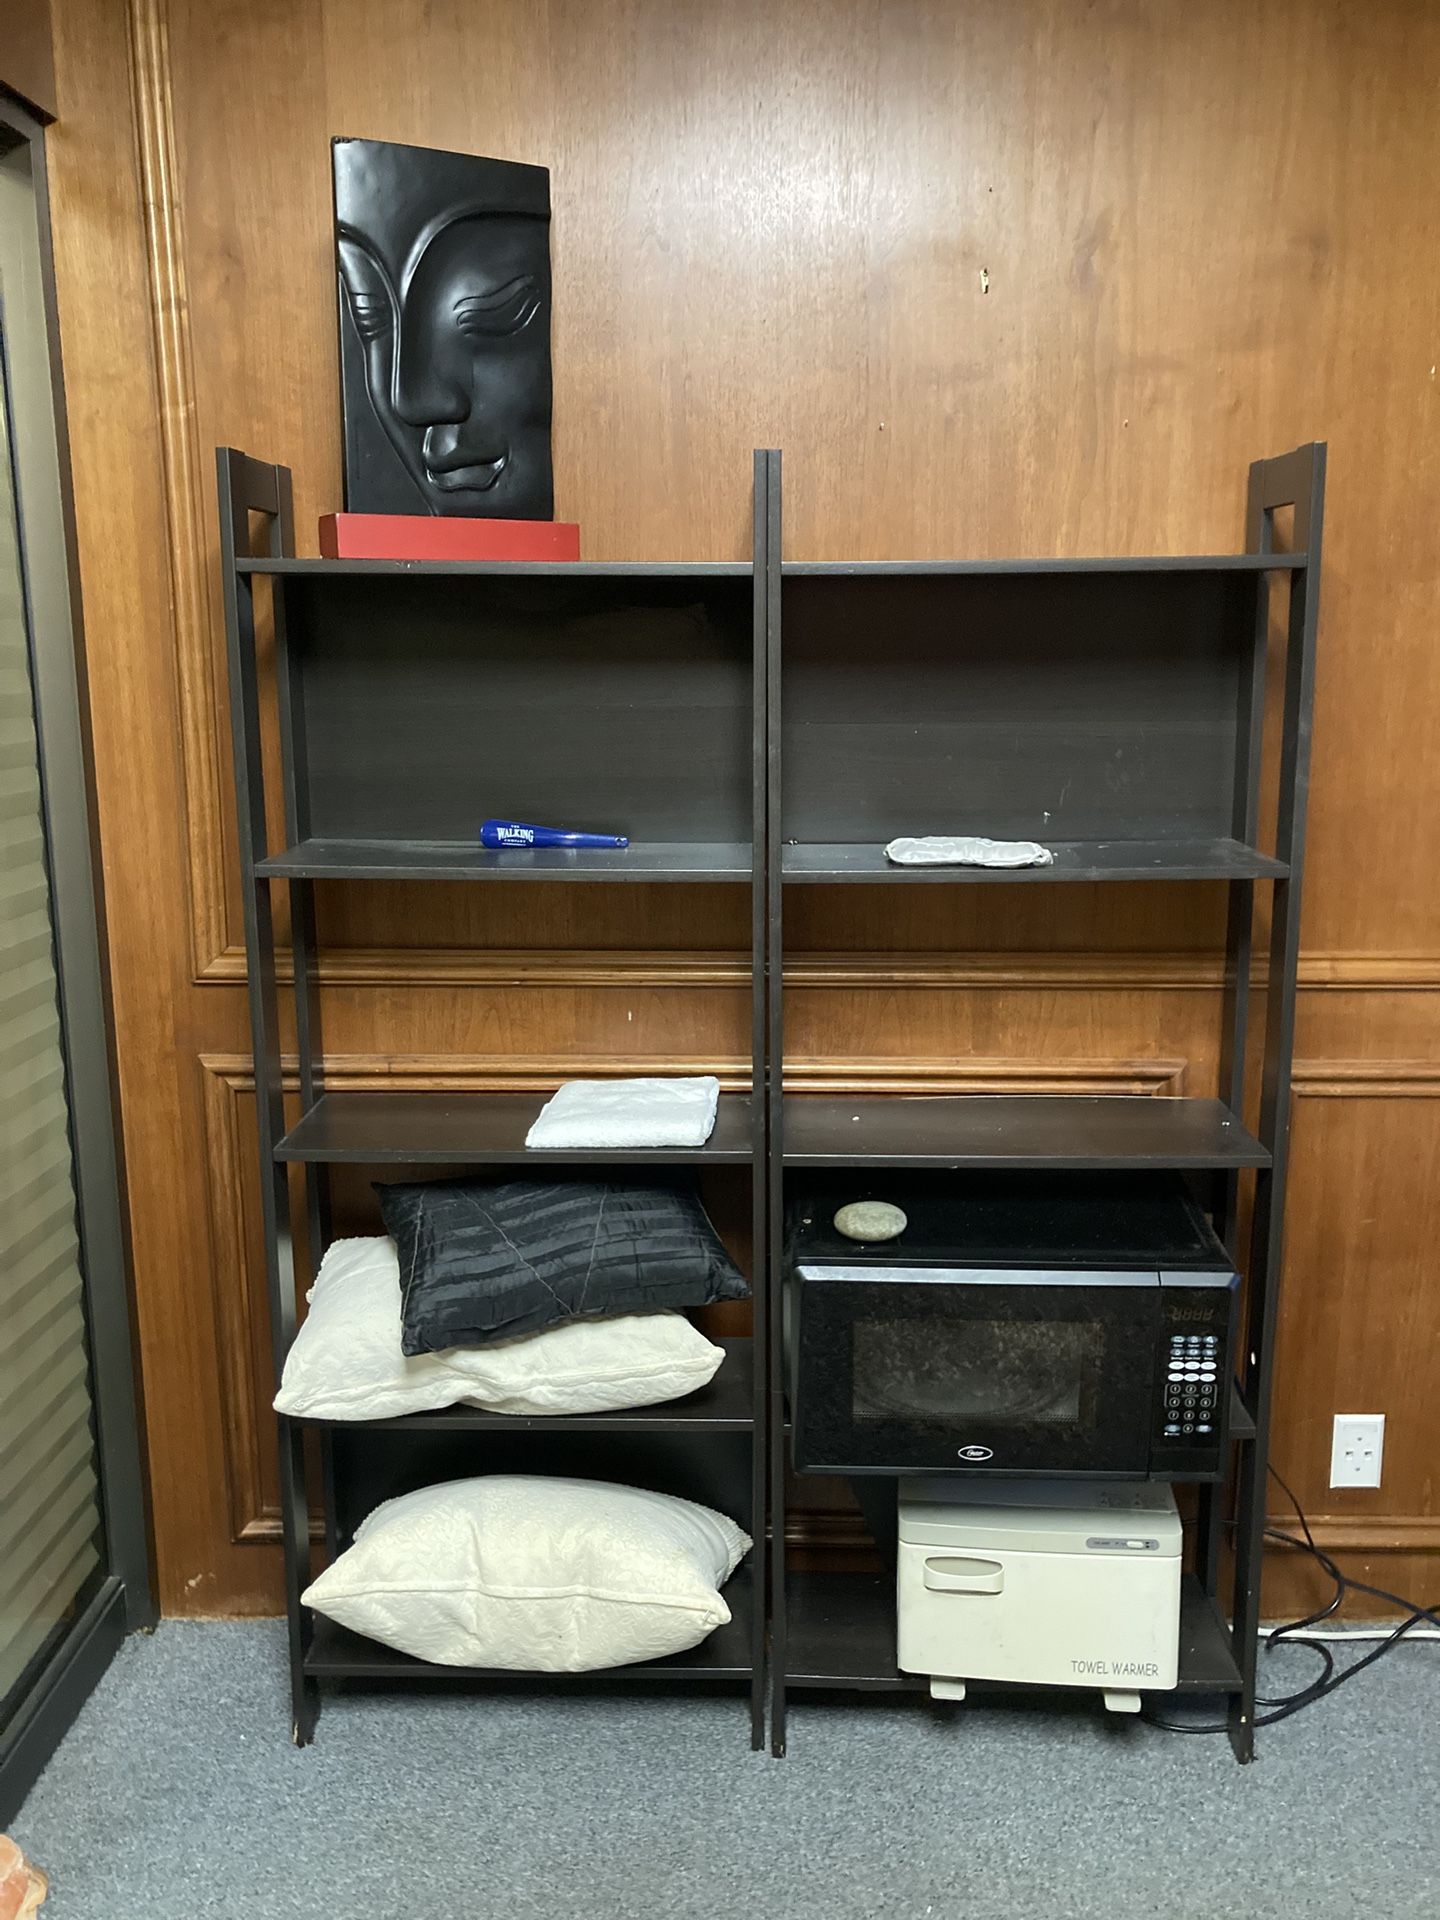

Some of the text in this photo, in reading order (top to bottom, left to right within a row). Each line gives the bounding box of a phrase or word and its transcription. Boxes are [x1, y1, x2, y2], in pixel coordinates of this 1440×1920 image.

[496, 827, 534, 843] WALKING
[1071, 1660, 1158, 1676] TOWEL WARMER
